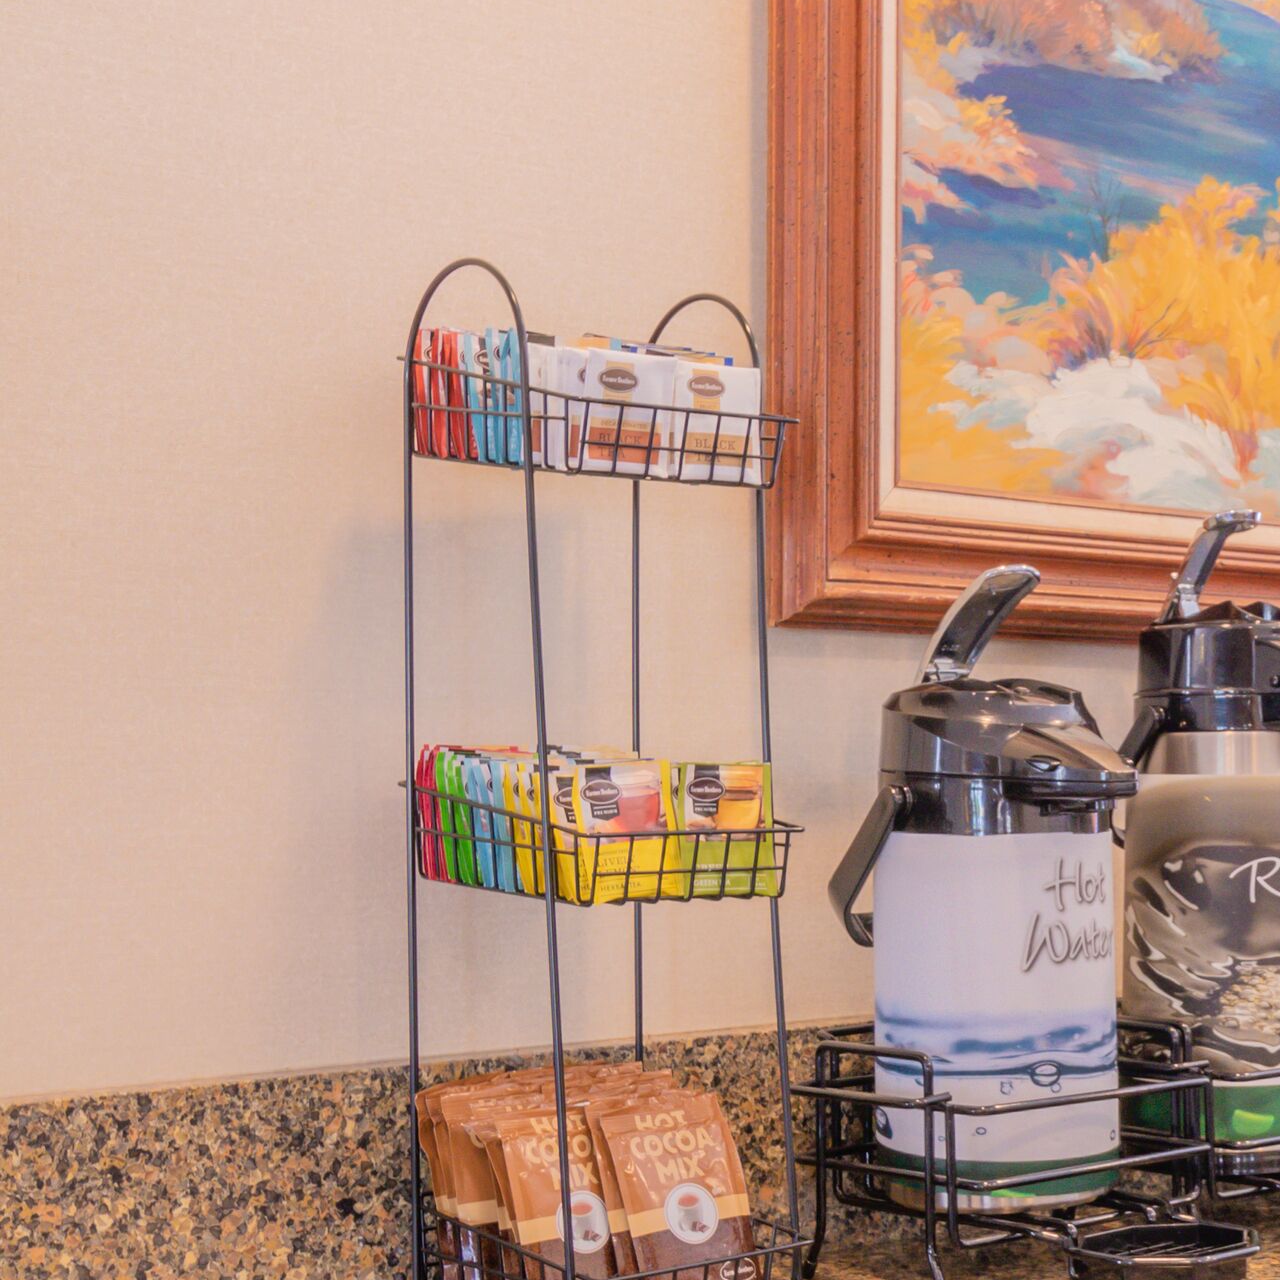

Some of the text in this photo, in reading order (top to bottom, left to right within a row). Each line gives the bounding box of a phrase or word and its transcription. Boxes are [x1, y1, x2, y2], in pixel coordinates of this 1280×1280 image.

[1043, 856, 1106, 913] Hot
[634, 1109, 688, 1132] HOT
[524, 1133, 592, 1165] COO
[629, 1126, 716, 1161] COCOA
[654, 1153, 706, 1185] MIX
